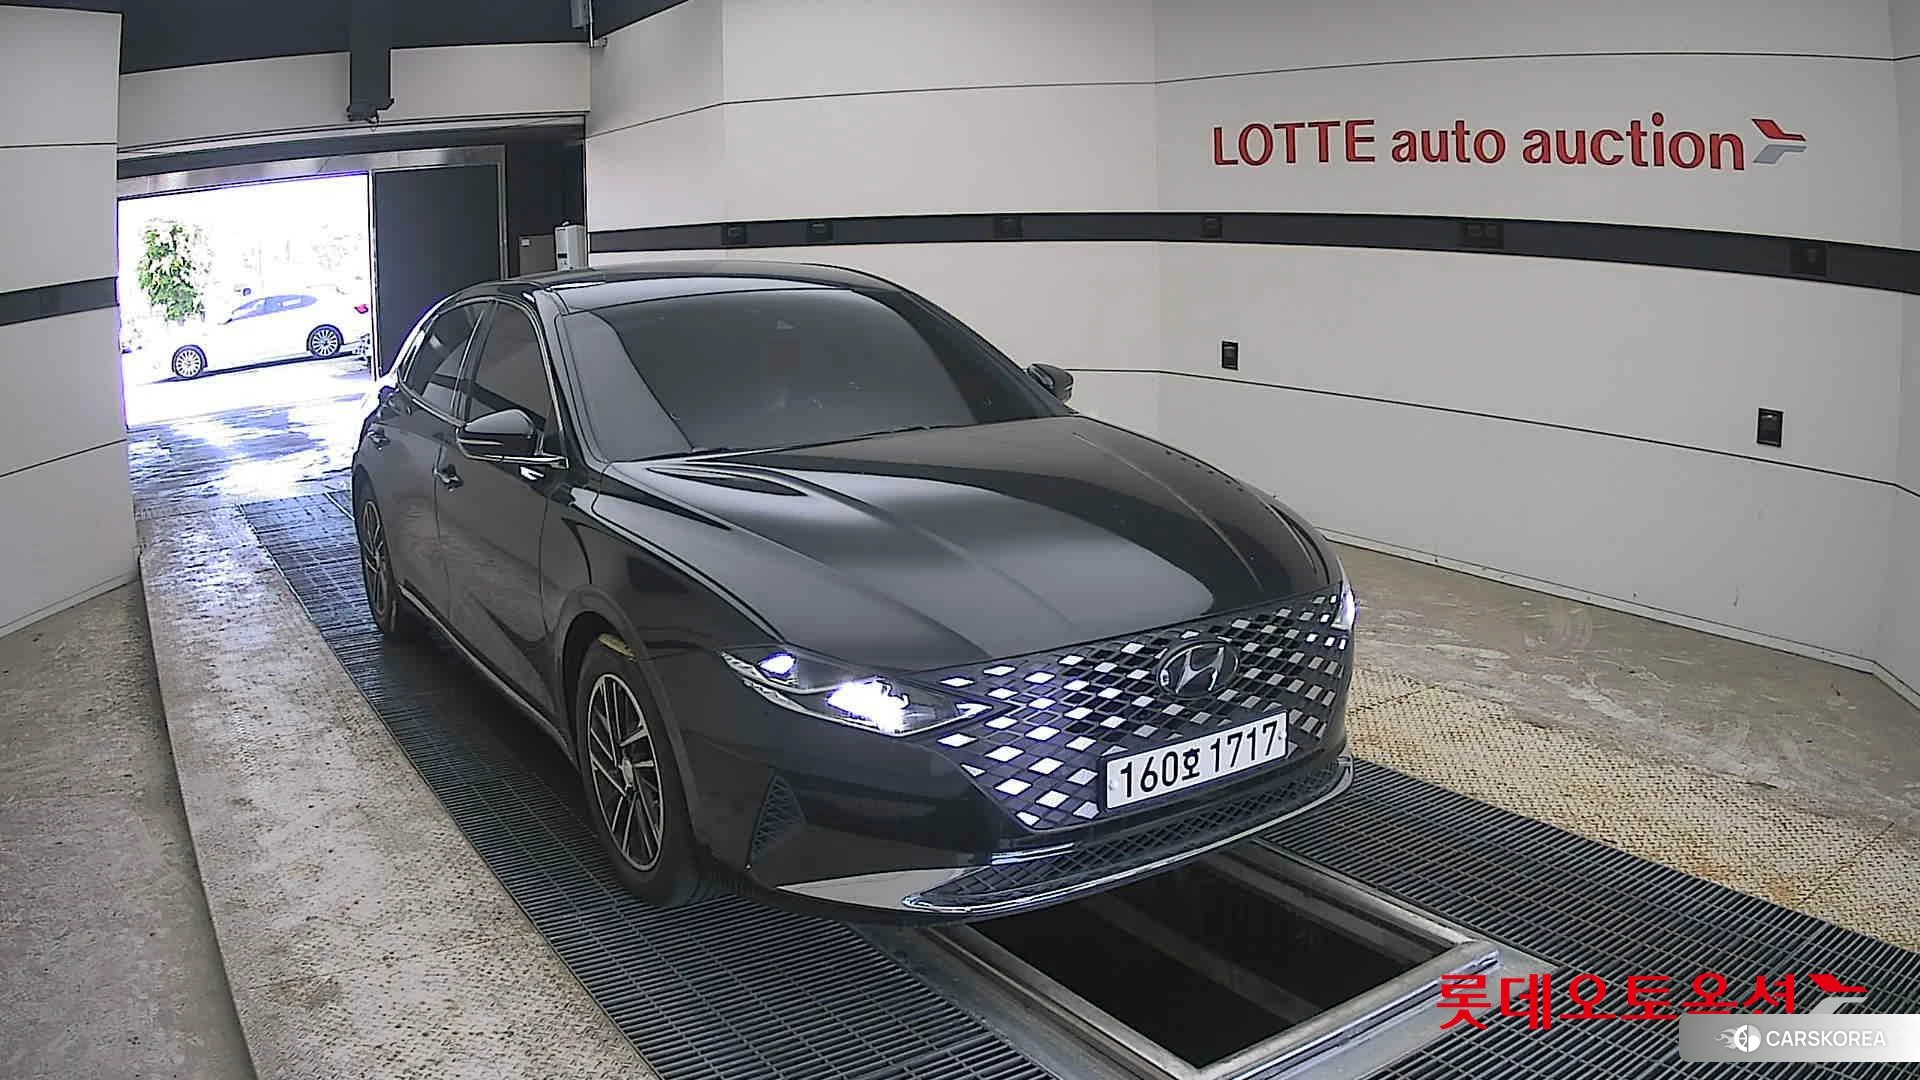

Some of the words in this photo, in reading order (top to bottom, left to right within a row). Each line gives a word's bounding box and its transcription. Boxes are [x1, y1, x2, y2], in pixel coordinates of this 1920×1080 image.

[1213, 119, 1376, 166] LOTTE
[1391, 120, 1506, 163] auto
[1522, 112, 1745, 171] auction
[1120, 748, 1200, 798] 160호
[1210, 720, 1278, 773] 1717
